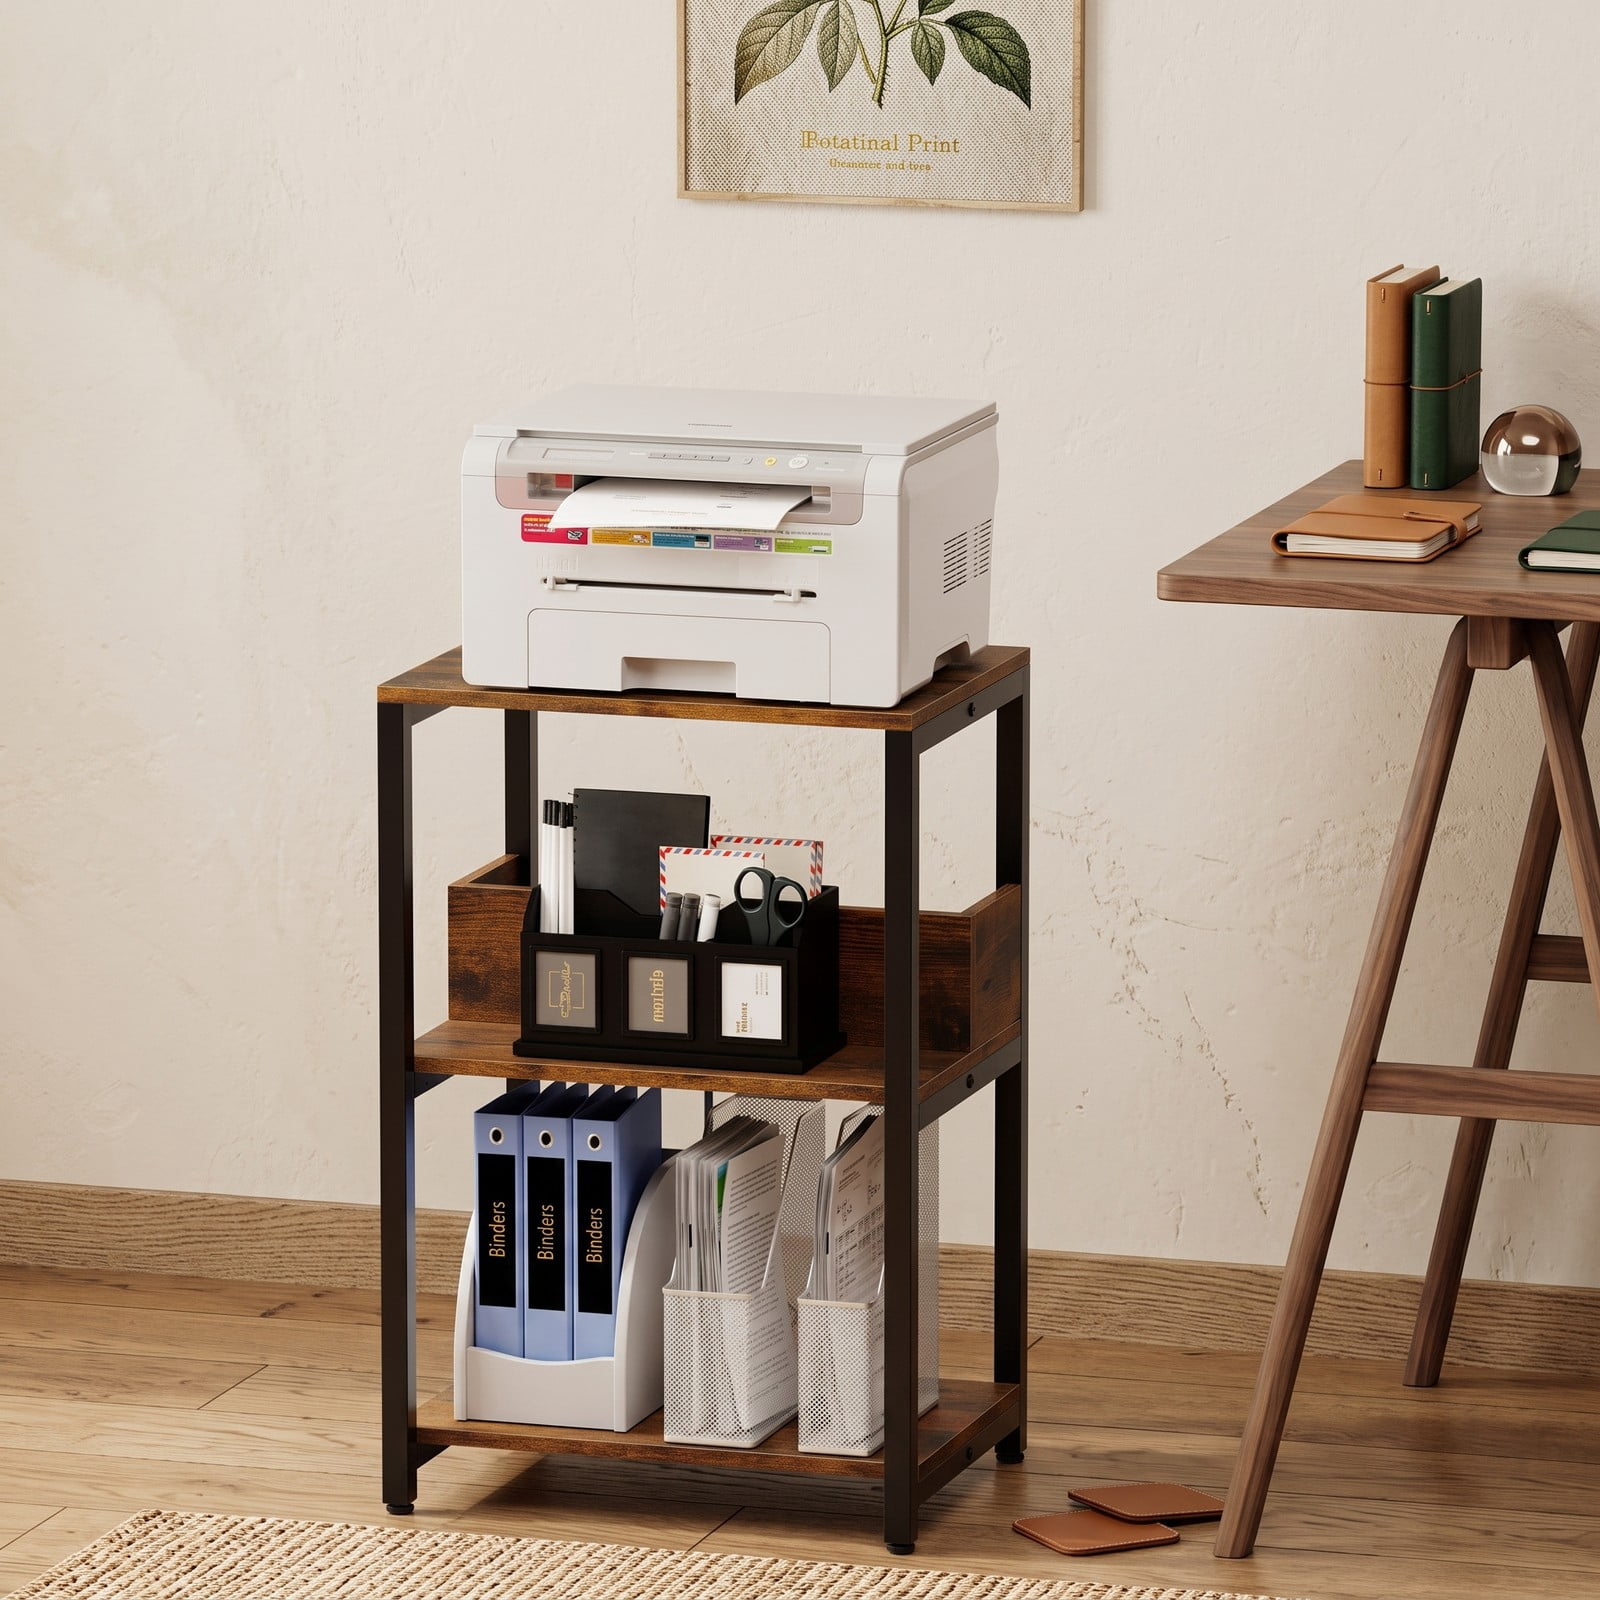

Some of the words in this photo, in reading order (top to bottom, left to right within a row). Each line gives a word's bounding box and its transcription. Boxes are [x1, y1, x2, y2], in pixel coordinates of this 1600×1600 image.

[908, 133, 960, 153] Print
[488, 1201, 506, 1258] Binders
[537, 1204, 554, 1260] Binders
[585, 1208, 603, 1263] Binders
